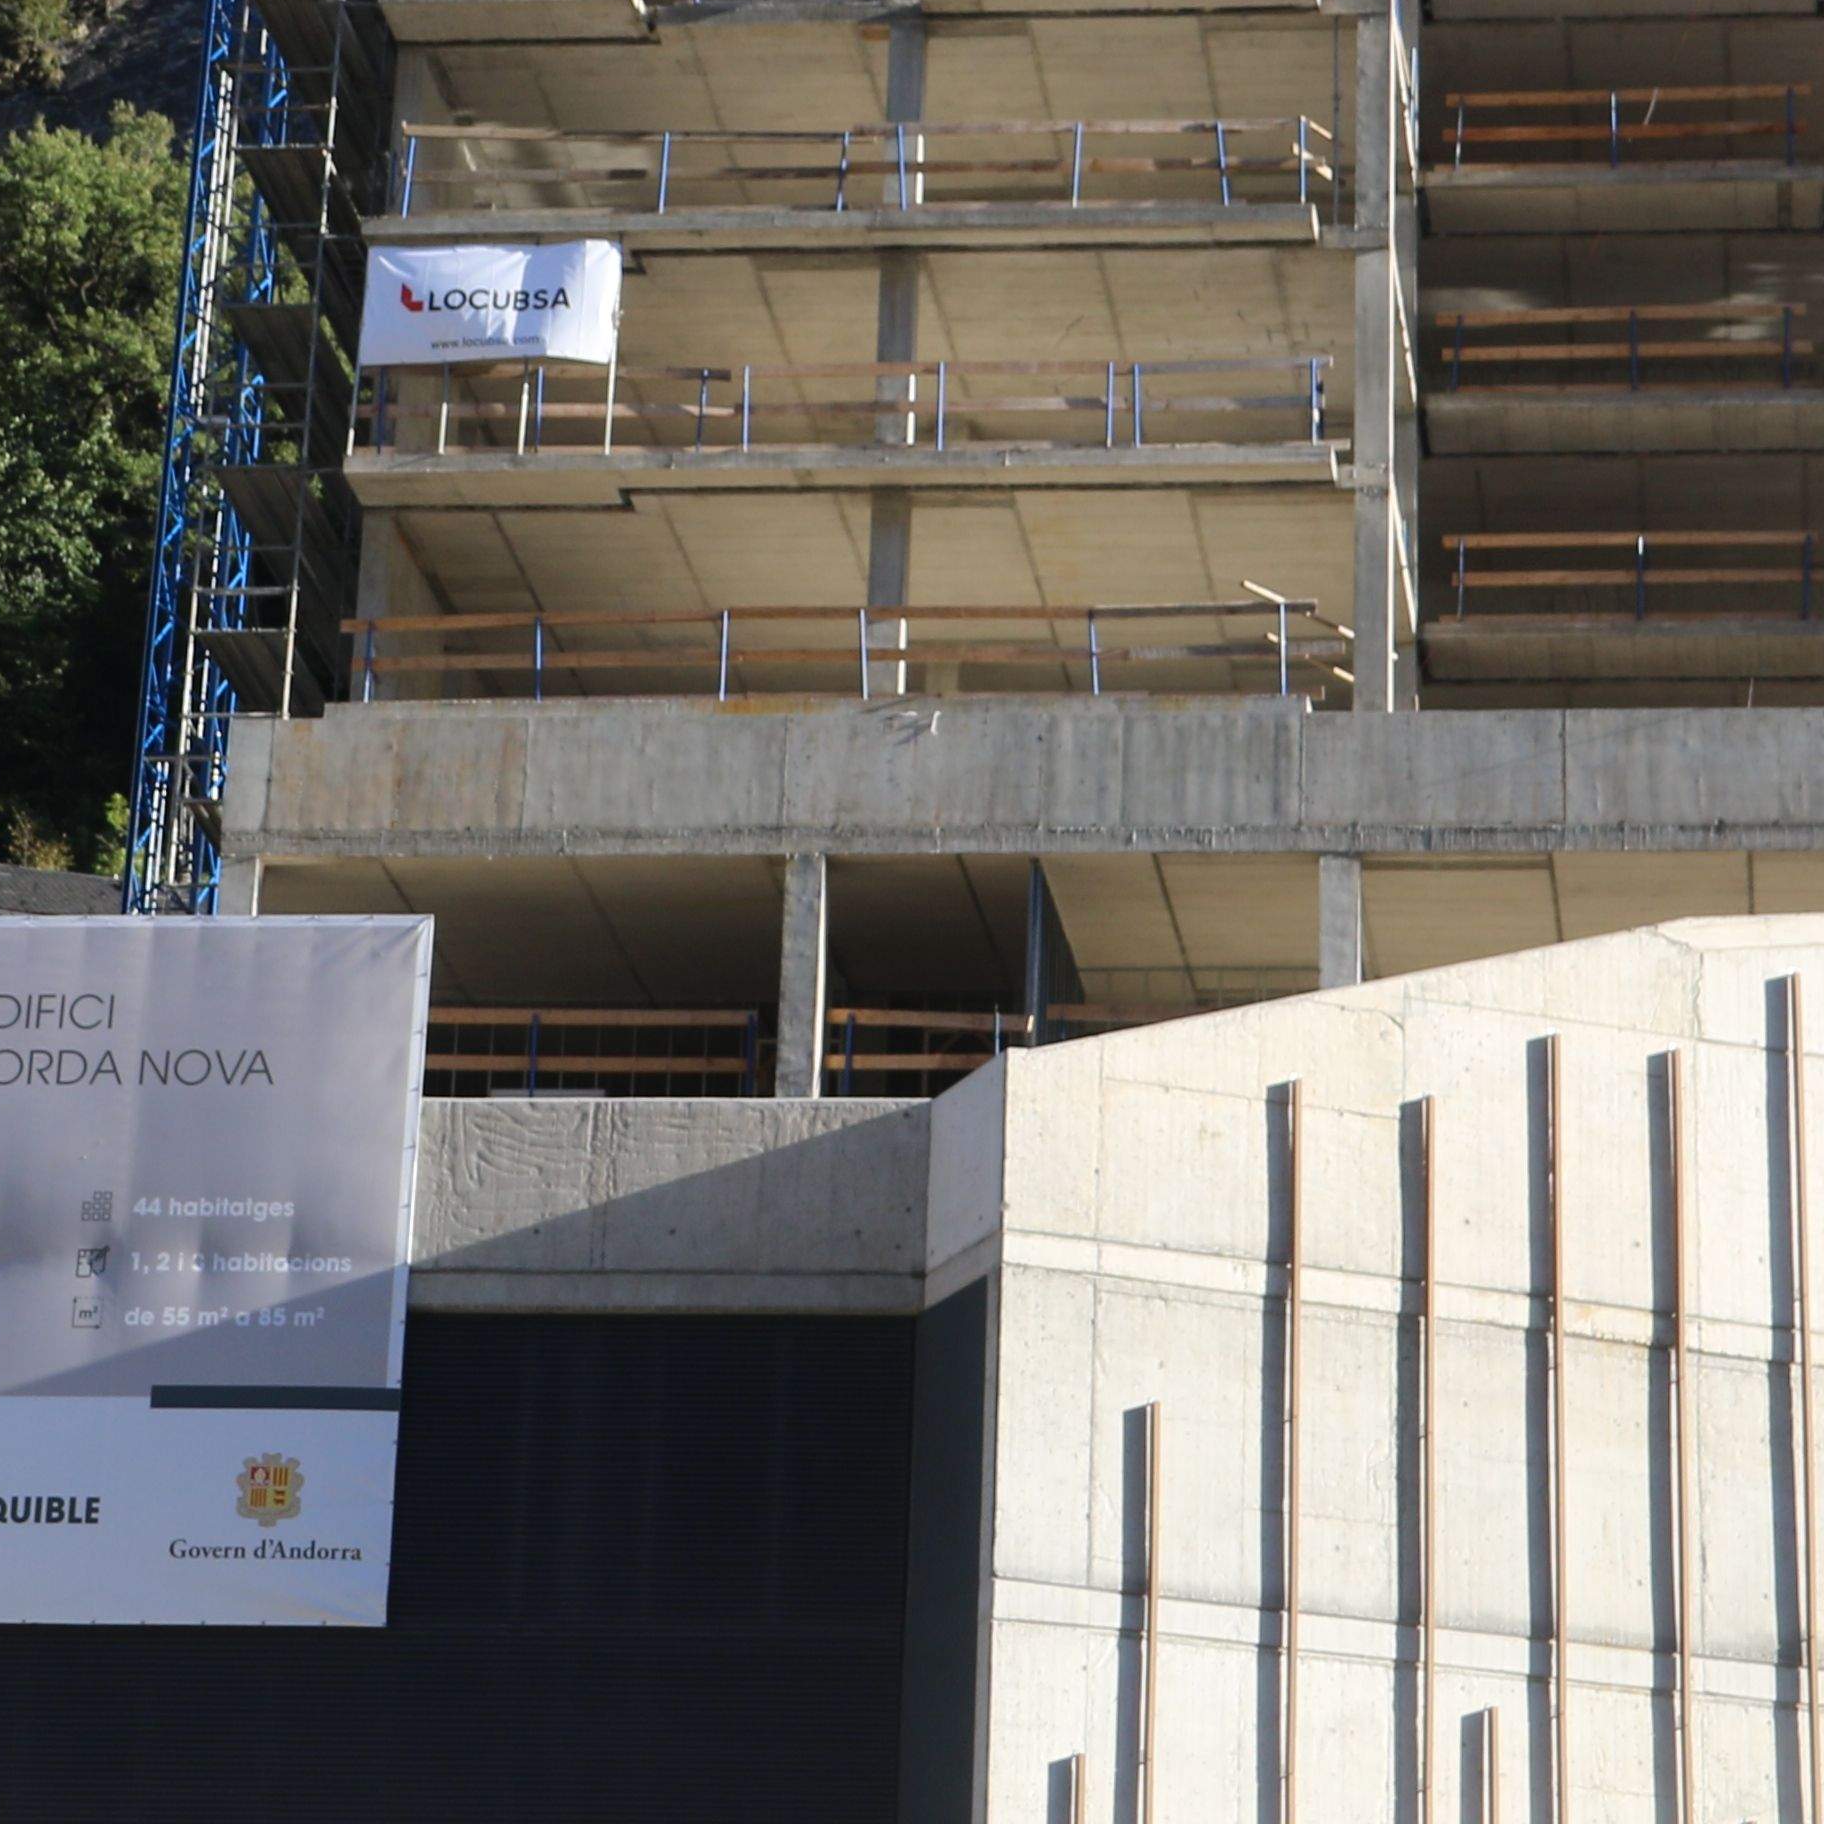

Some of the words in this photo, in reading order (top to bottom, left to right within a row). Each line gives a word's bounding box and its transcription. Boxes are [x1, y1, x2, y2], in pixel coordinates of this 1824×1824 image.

[138, 1049, 274, 1086] NOVA
[132, 1198, 161, 1216] 44
[169, 1197, 295, 1221] habitatges
[130, 1253, 149, 1274] 1,
[156, 1253, 170, 1271] 2
[177, 1253, 183, 1272] i
[213, 1253, 352, 1272] habitacions
[124, 1307, 155, 1326] de
[162, 1308, 190, 1326] 55
[235, 1312, 251, 1326] a
[258, 1308, 287, 1326] 85
[169, 1540, 245, 1559] Govern
